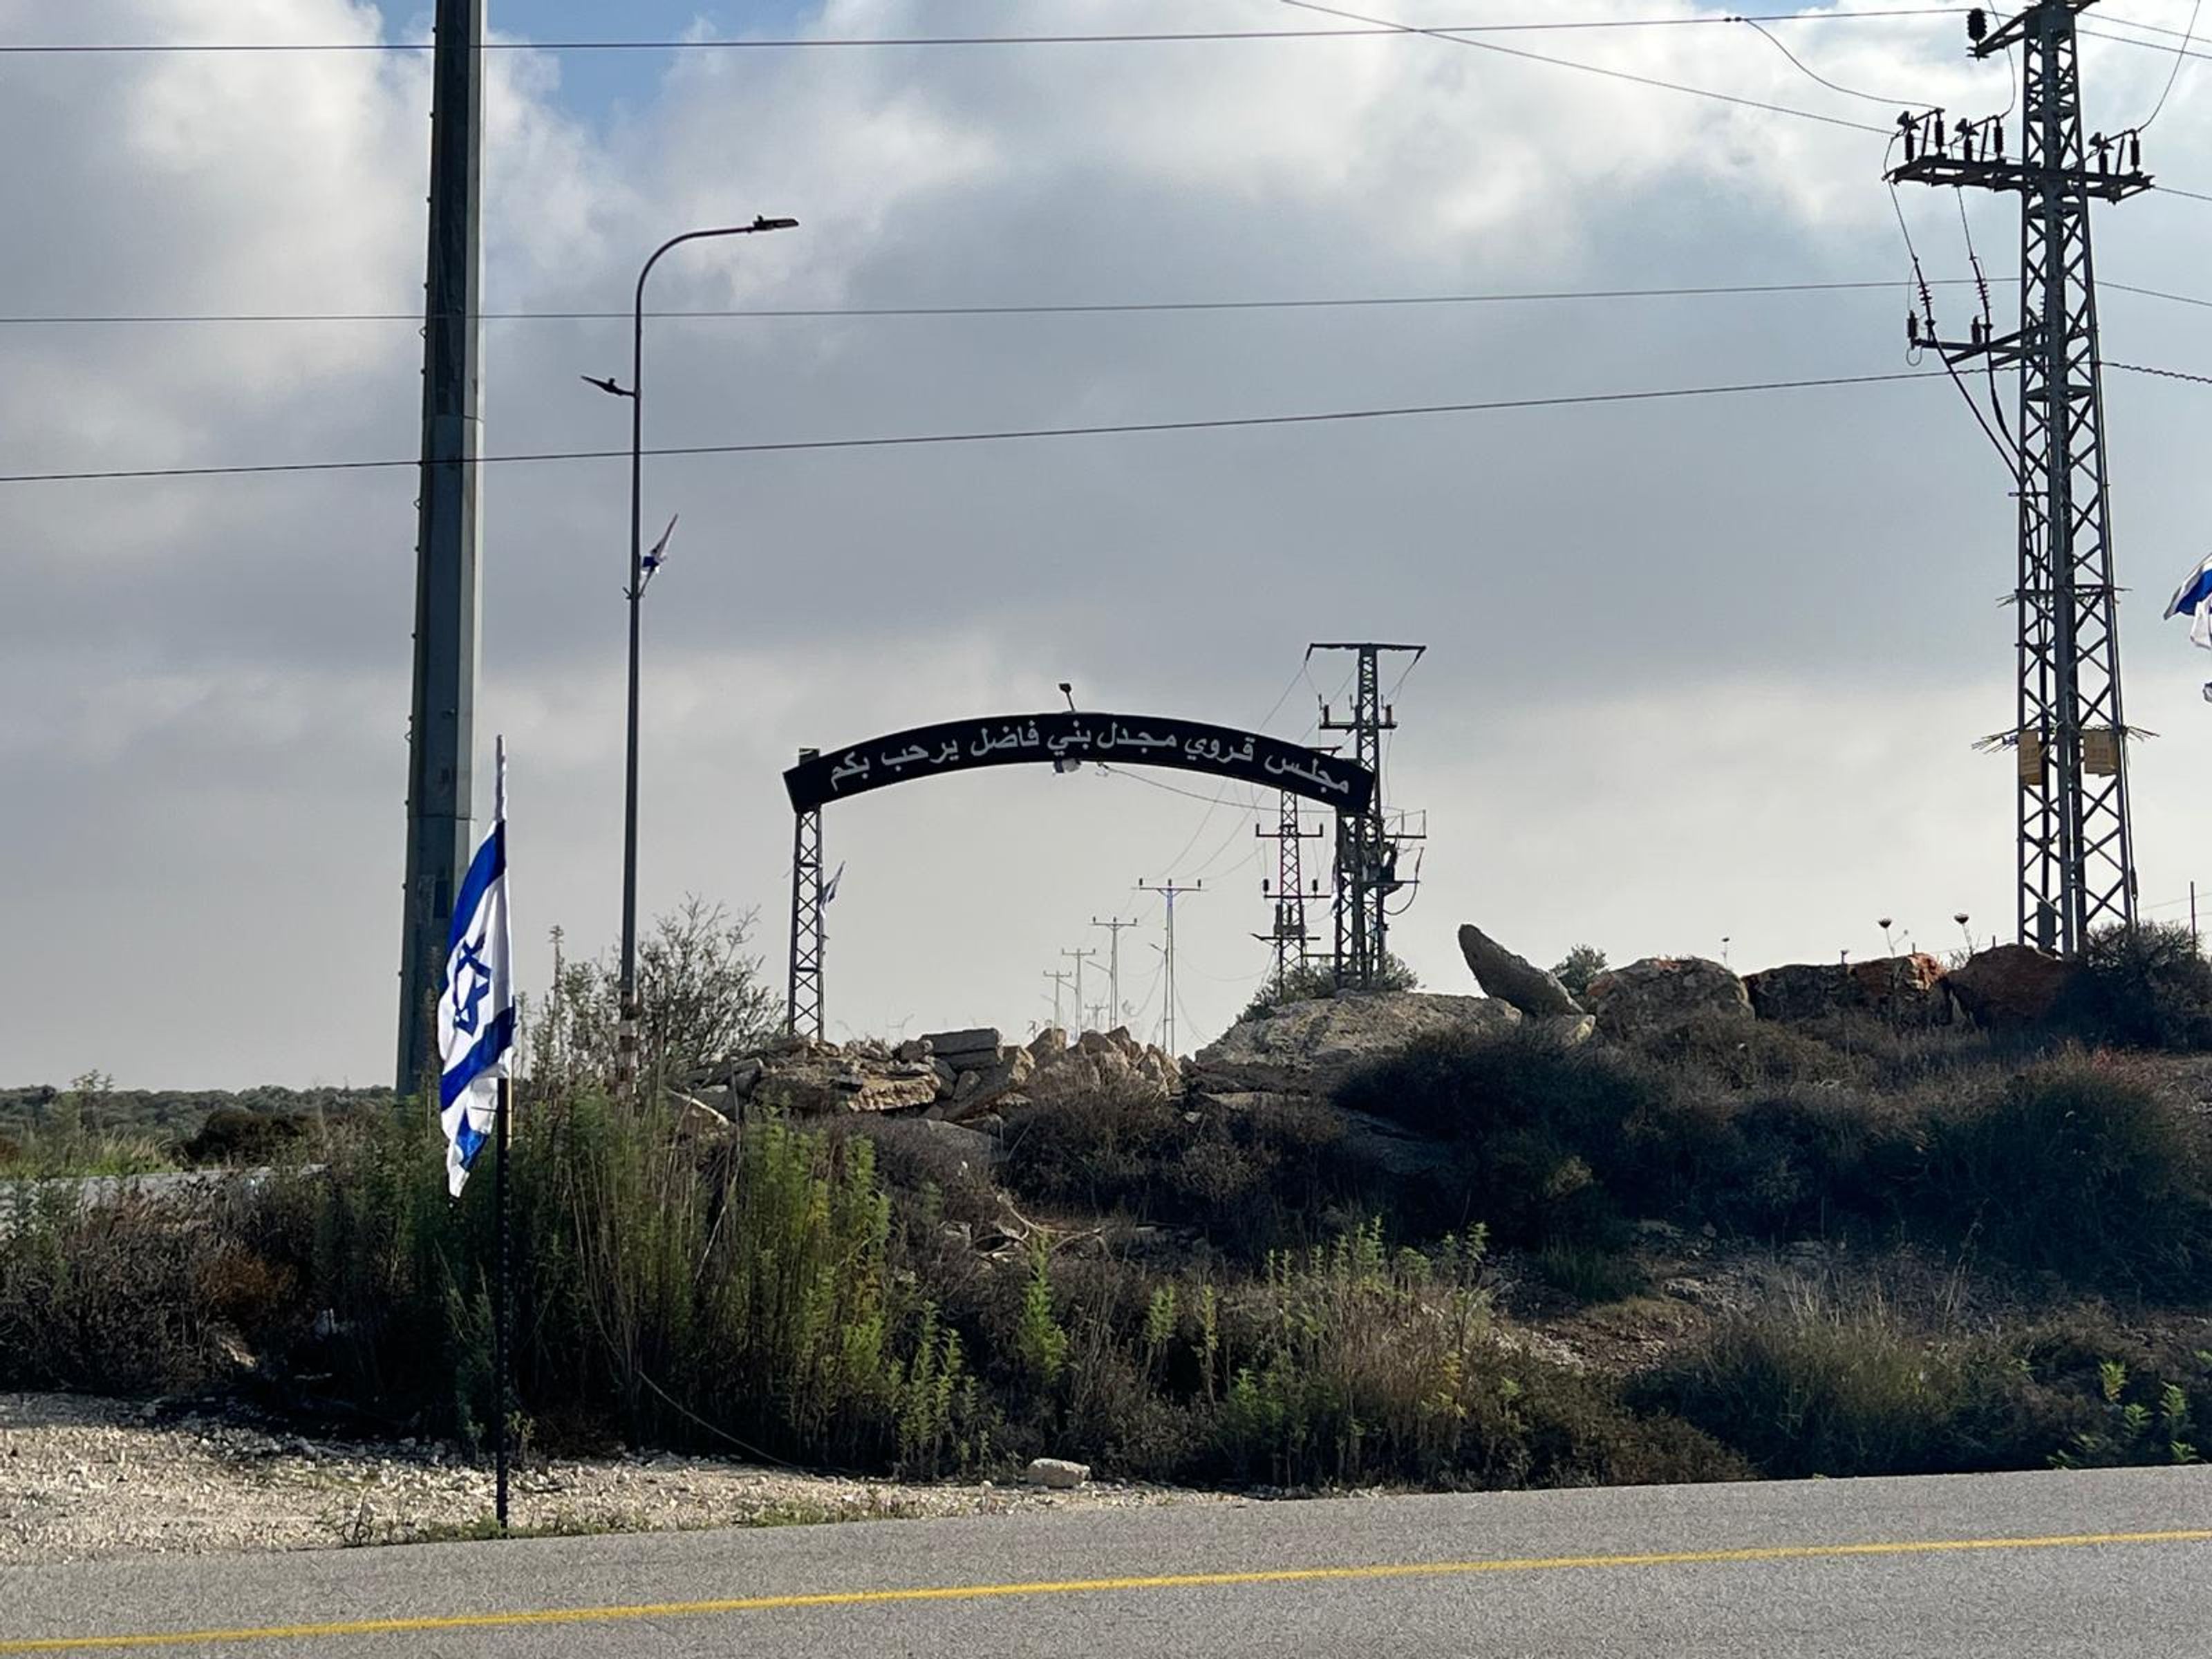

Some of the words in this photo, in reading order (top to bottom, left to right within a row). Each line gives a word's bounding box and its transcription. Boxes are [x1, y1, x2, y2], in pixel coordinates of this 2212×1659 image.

[881, 739, 959, 771] يرحب
[971, 720, 1039, 756] فاضل
[1047, 720, 1091, 756] بني
[1096, 721, 1177, 753] مجدل
[1184, 737, 1255, 763] قروي
[830, 751, 870, 791] بكم
[1264, 756, 1349, 794] مجلس
